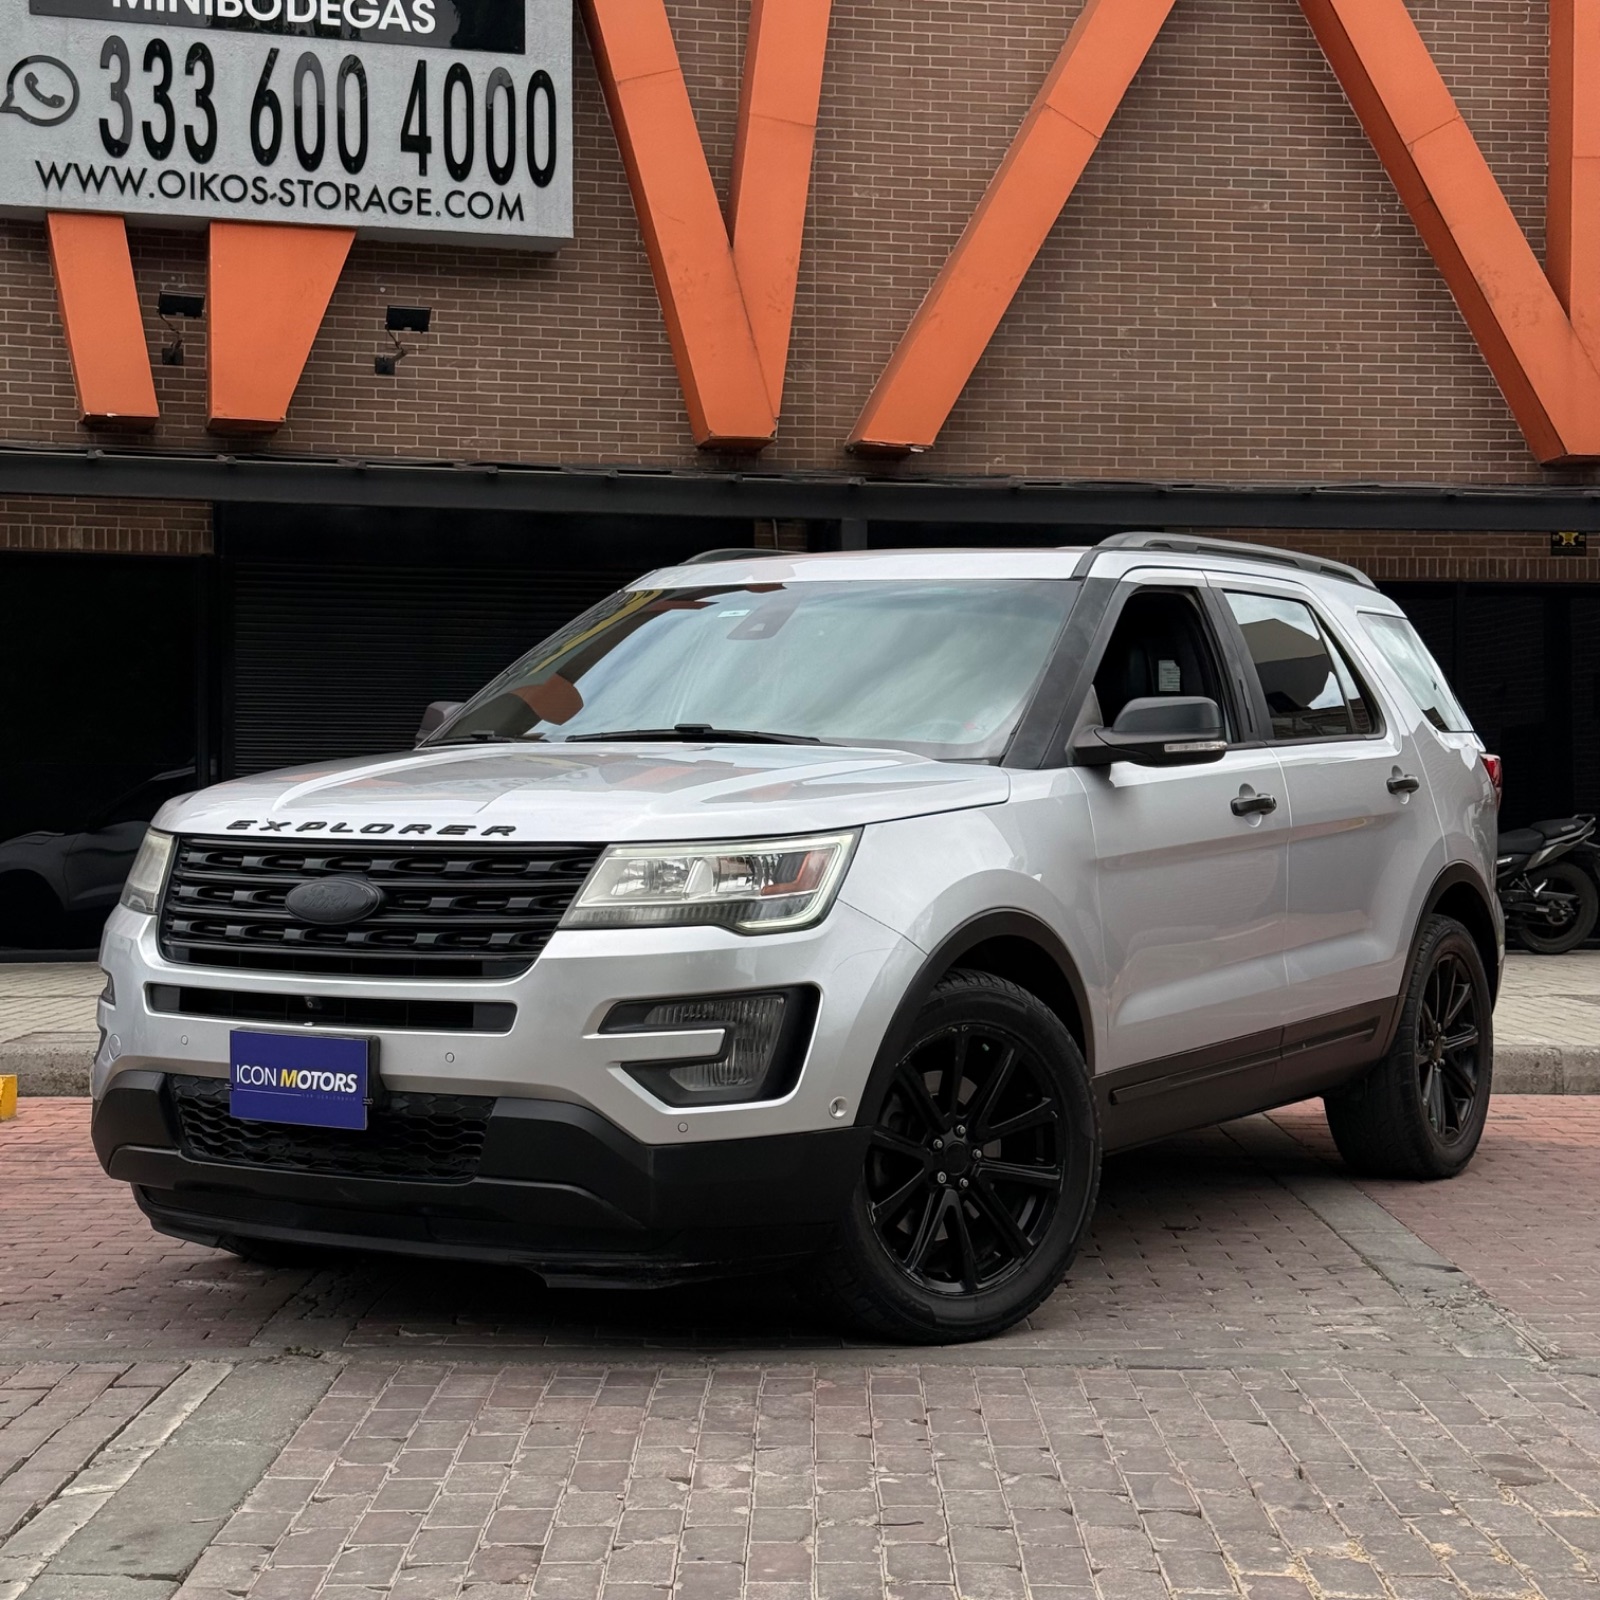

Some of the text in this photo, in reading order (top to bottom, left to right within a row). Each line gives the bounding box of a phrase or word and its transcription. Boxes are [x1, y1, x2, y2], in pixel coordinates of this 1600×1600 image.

[112, 0, 436, 34] BODEGAS
[99, 35, 558, 188] 333 600 4000
[35, 160, 525, 222] WWW.OIKOS-STORAGE.COM
[226, 819, 517, 836] EXPLORER
[236, 1064, 358, 1093] ICON MOTORS
